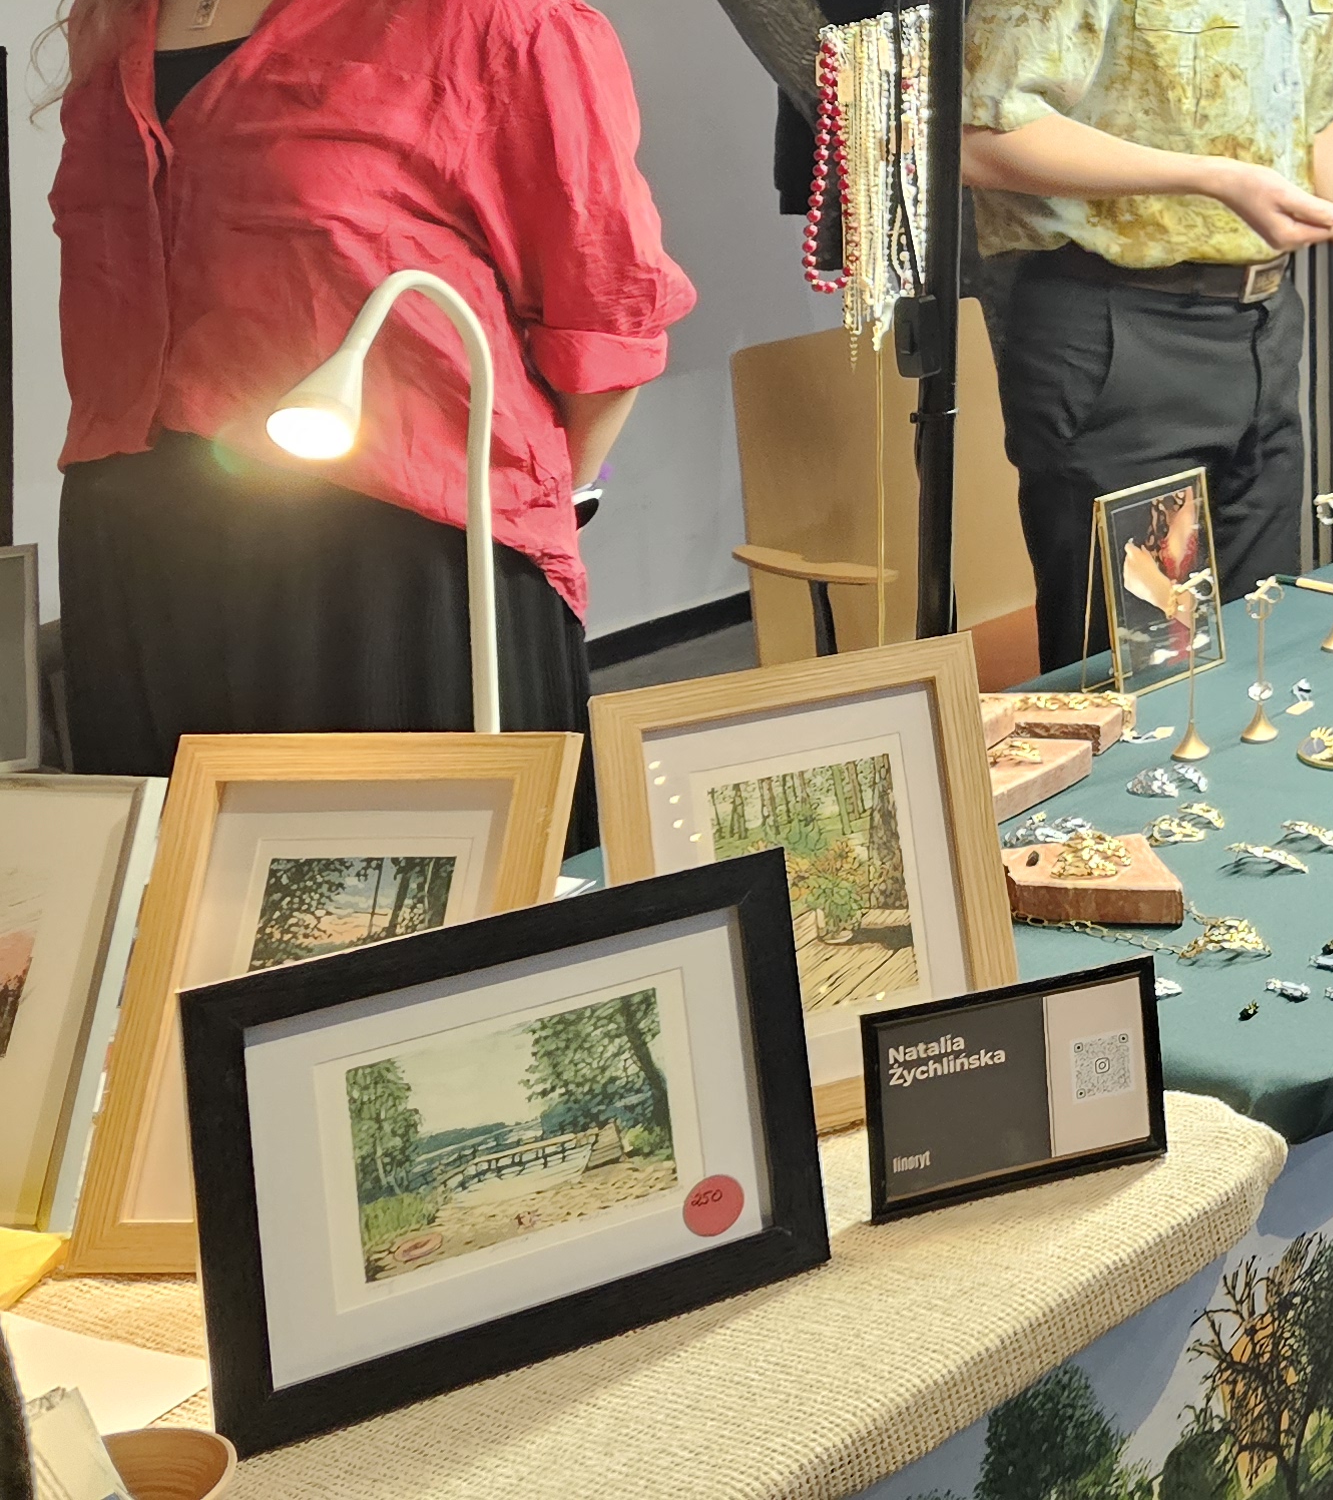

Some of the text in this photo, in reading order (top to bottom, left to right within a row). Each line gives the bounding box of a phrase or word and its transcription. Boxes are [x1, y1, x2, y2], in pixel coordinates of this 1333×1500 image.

[888, 1034, 965, 1065] Natalia
[888, 1048, 1006, 1087] Żychlińska
[691, 1189, 724, 1207] 250
